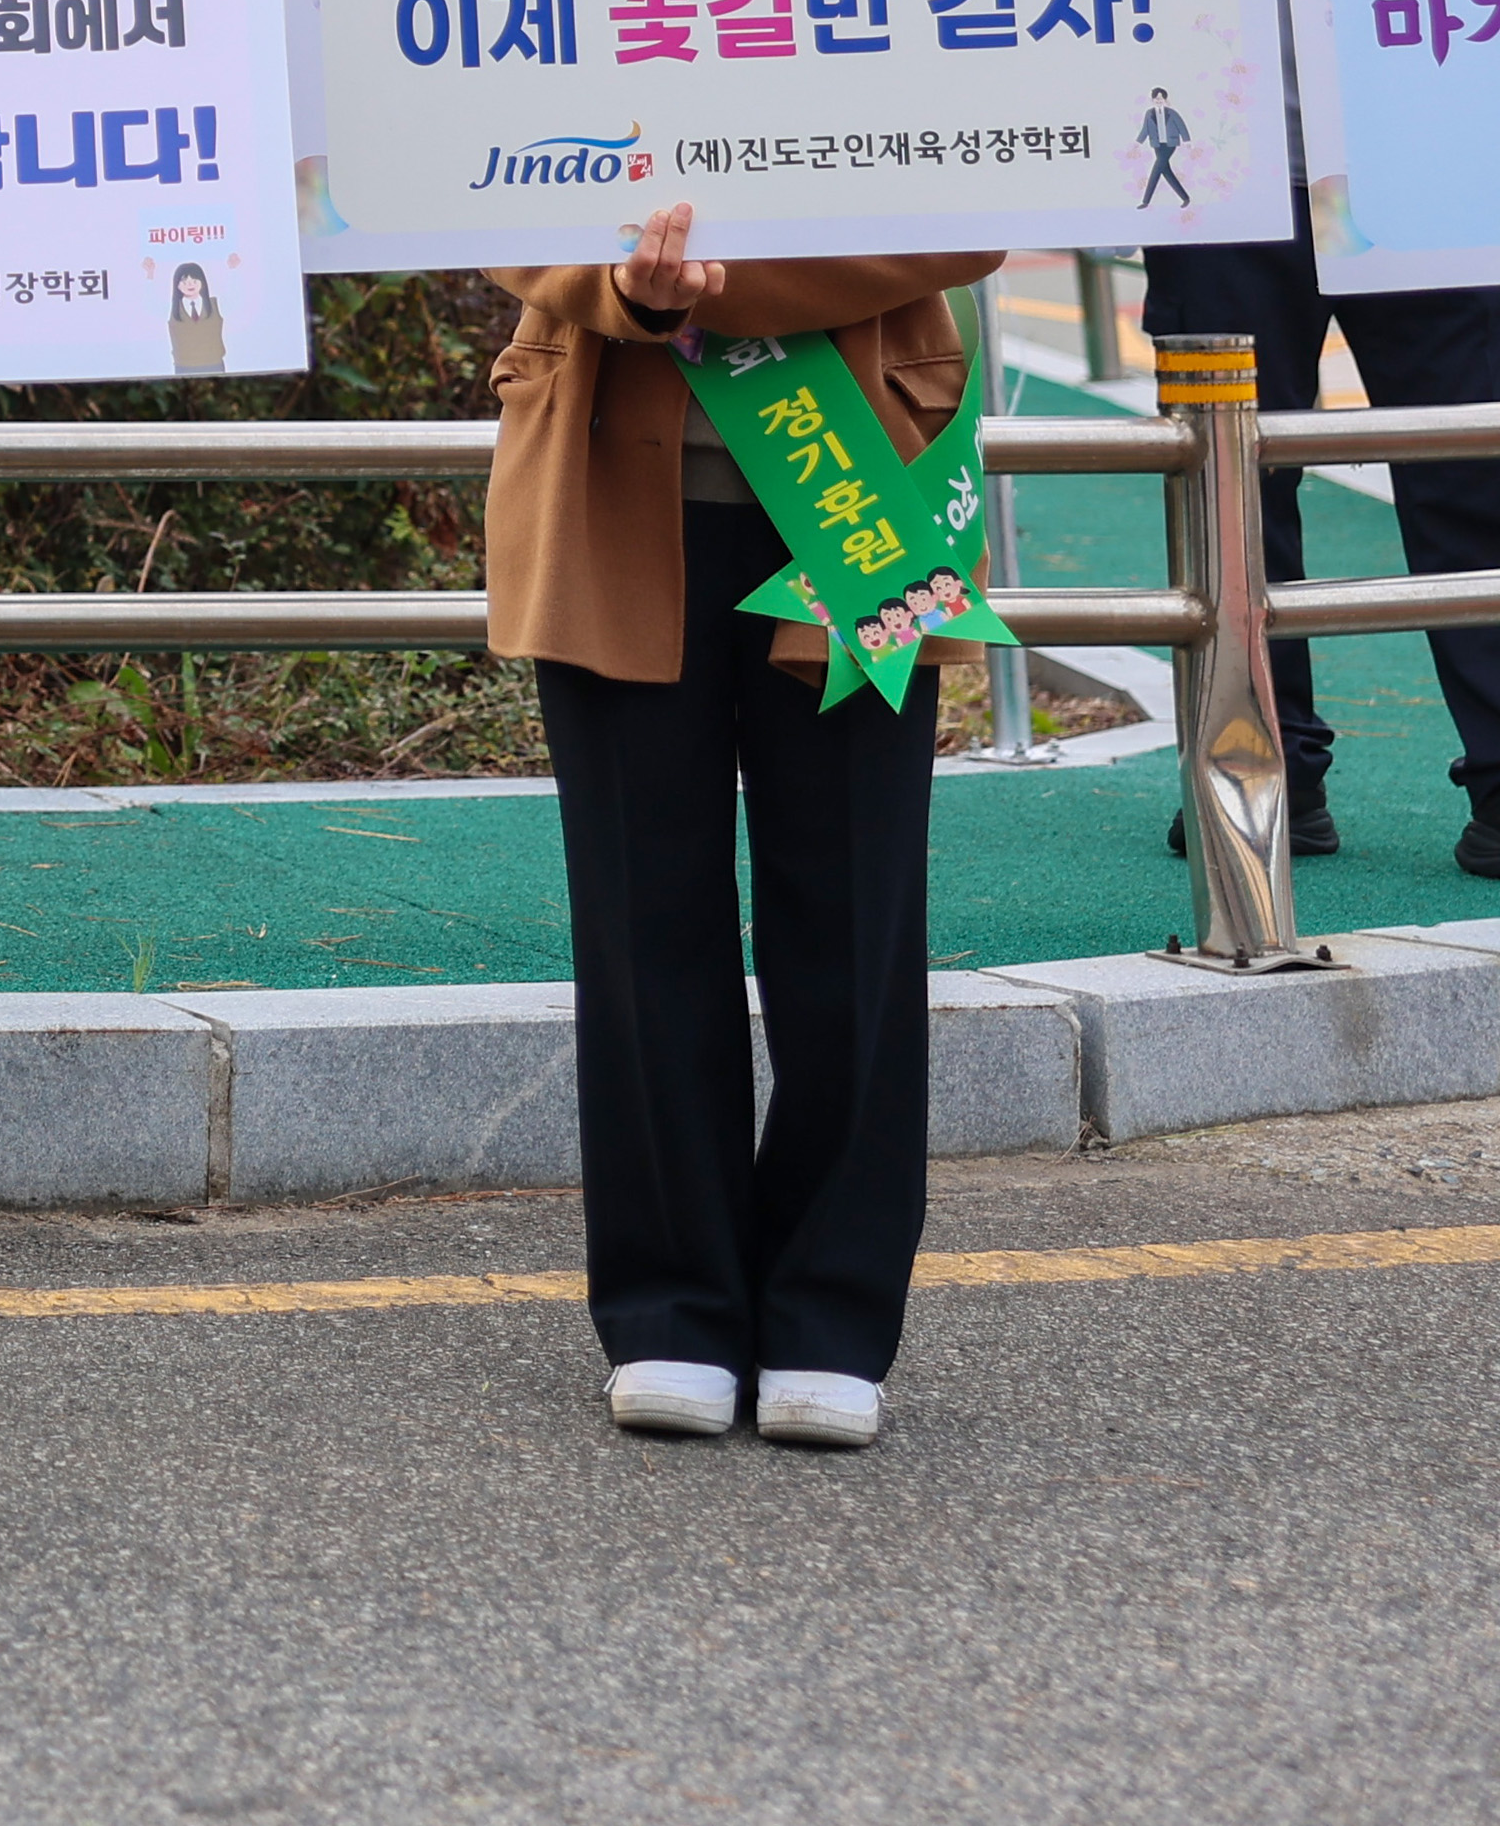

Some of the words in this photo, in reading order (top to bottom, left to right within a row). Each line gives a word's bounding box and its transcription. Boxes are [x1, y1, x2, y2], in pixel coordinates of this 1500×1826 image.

[469, 134, 623, 191] Jindo
[674, 123, 1091, 176] (재)진도군인재육성장학회
[757, 385, 909, 576] 정기후원
